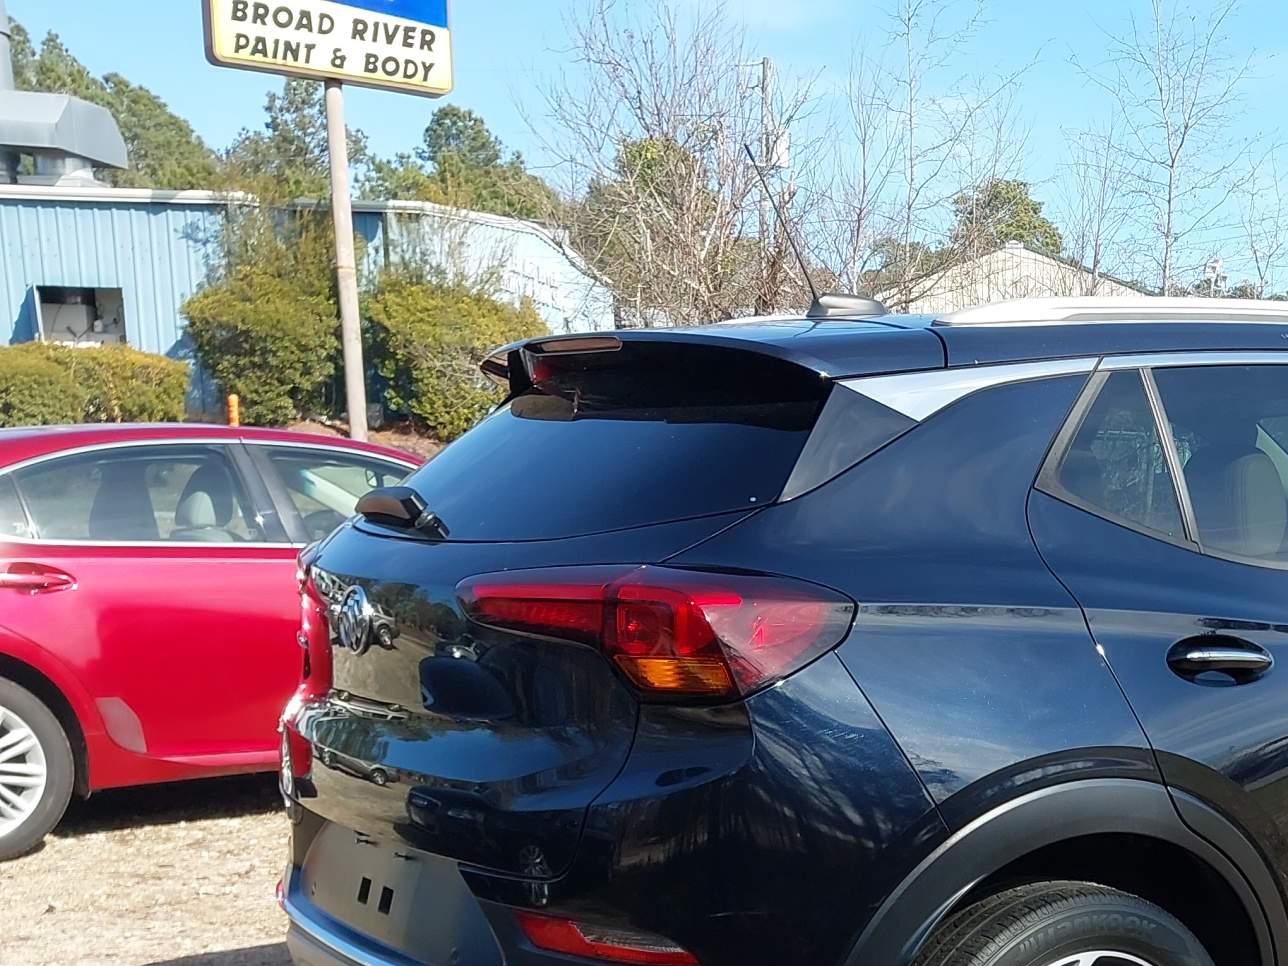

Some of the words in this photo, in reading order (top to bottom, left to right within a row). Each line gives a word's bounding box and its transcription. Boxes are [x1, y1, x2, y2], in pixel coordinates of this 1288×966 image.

[231, 0, 335, 34] BROAD
[350, 18, 436, 51] RIVER
[234, 33, 316, 64] PAINT
[330, 48, 347, 69] &
[364, 53, 435, 82] BODY
